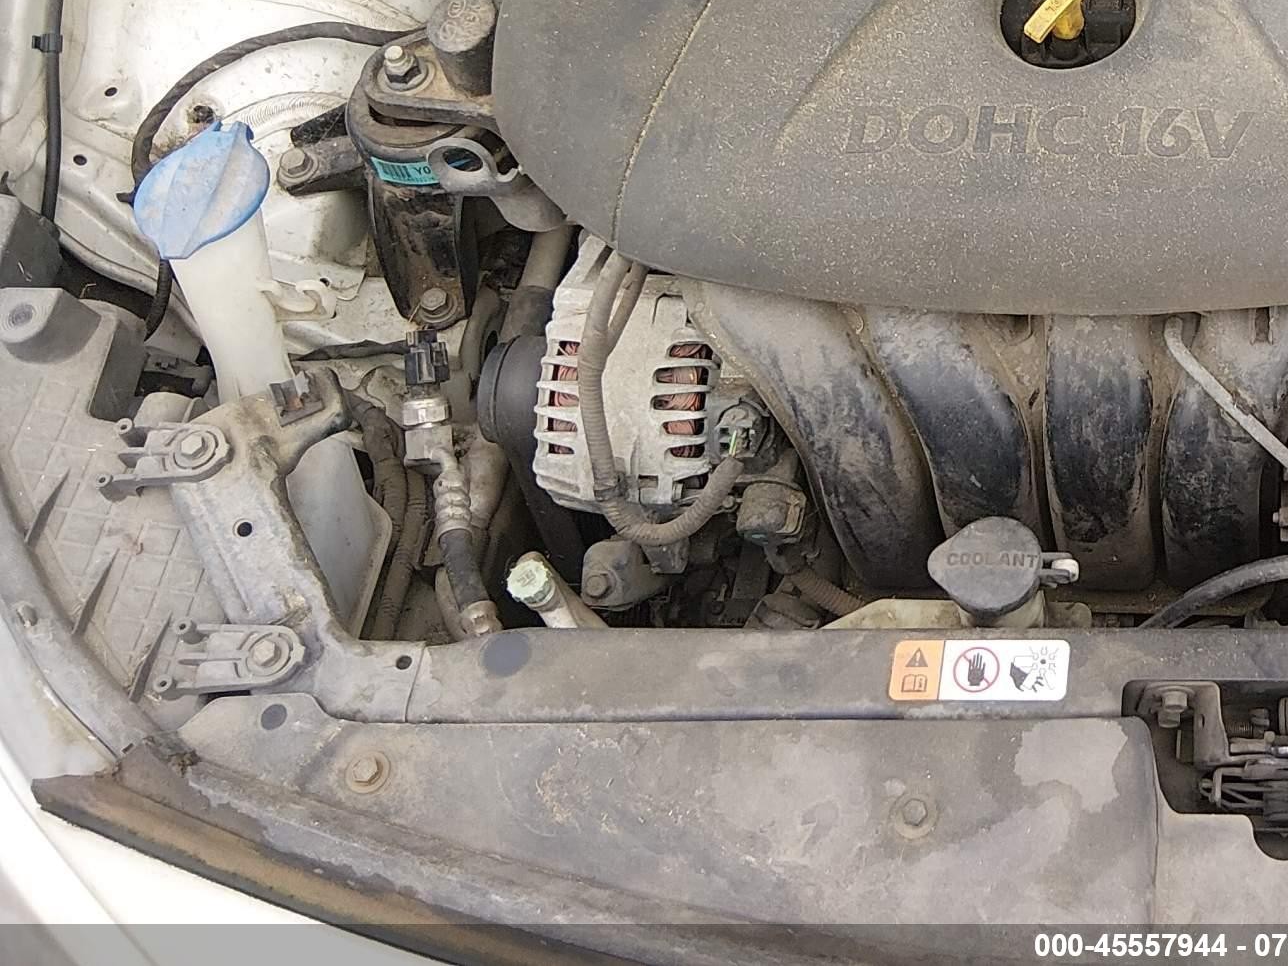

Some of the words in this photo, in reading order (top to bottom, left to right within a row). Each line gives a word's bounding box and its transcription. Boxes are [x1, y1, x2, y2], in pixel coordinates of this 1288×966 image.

[843, 104, 1087, 156] DOHC
[1117, 106, 1256, 159] 16V
[946, 552, 1039, 569] COOLANT
